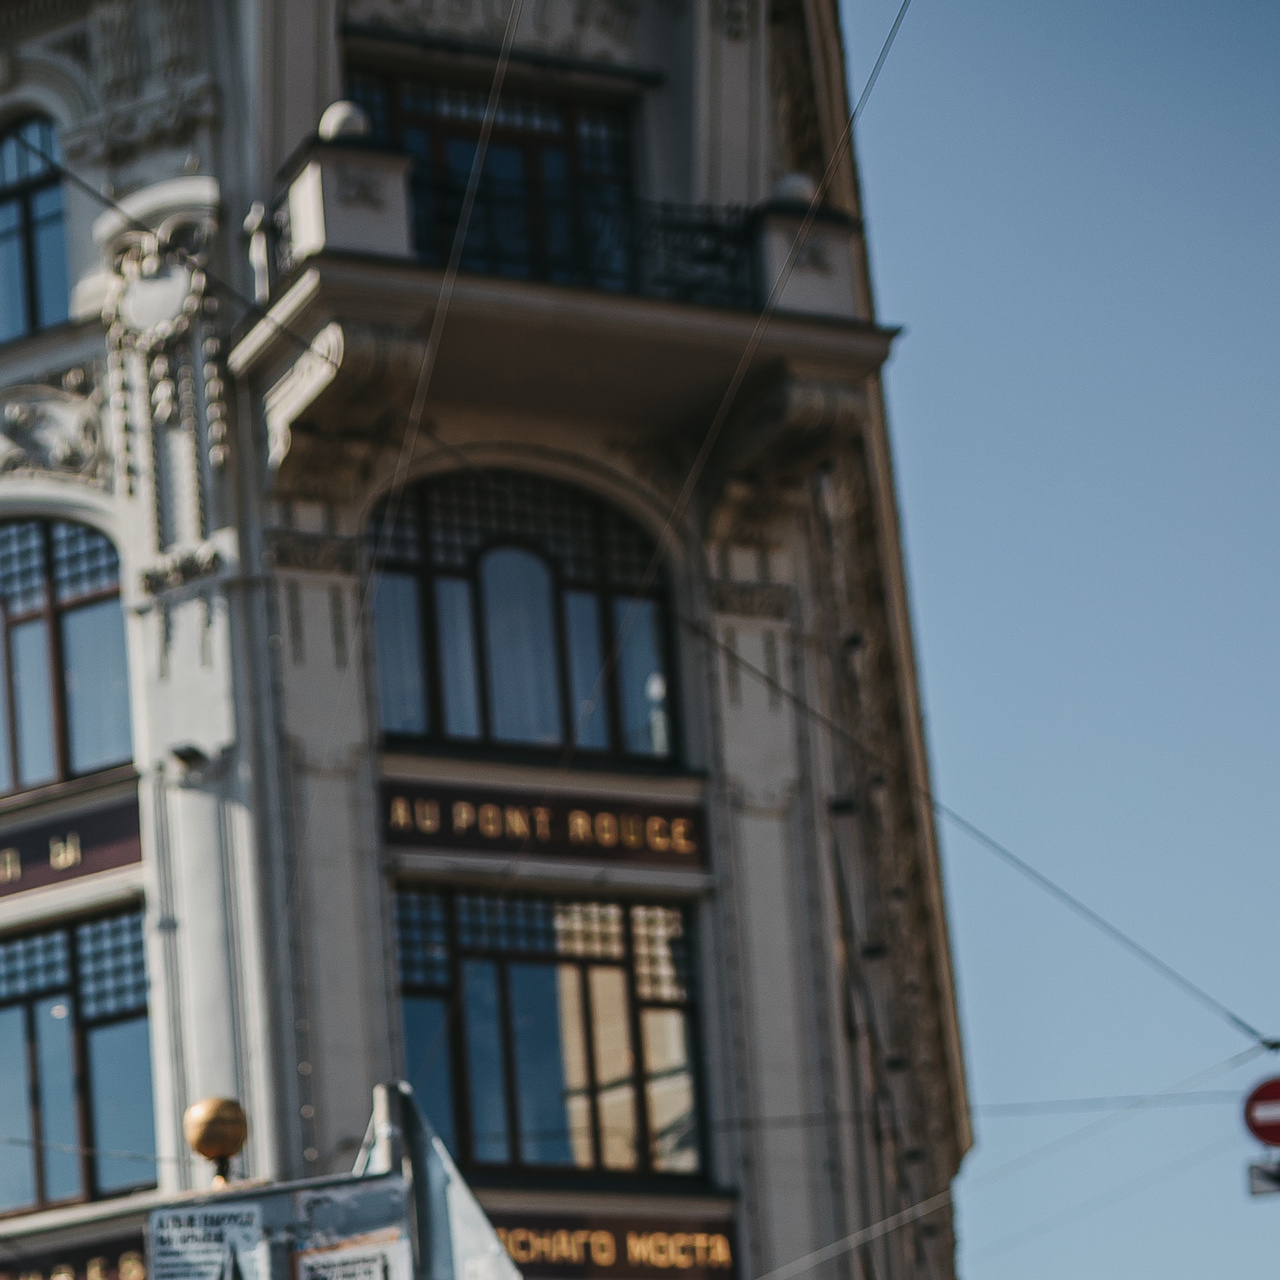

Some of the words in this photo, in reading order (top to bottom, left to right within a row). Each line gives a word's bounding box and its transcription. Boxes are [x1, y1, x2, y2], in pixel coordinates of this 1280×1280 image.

[389, 796, 440, 834] AU
[452, 801, 552, 842] PONT
[568, 809, 698, 854] ROUGE
[497, 1226, 616, 1268] СНАГО
[626, 1230, 733, 1270] МОСТА
